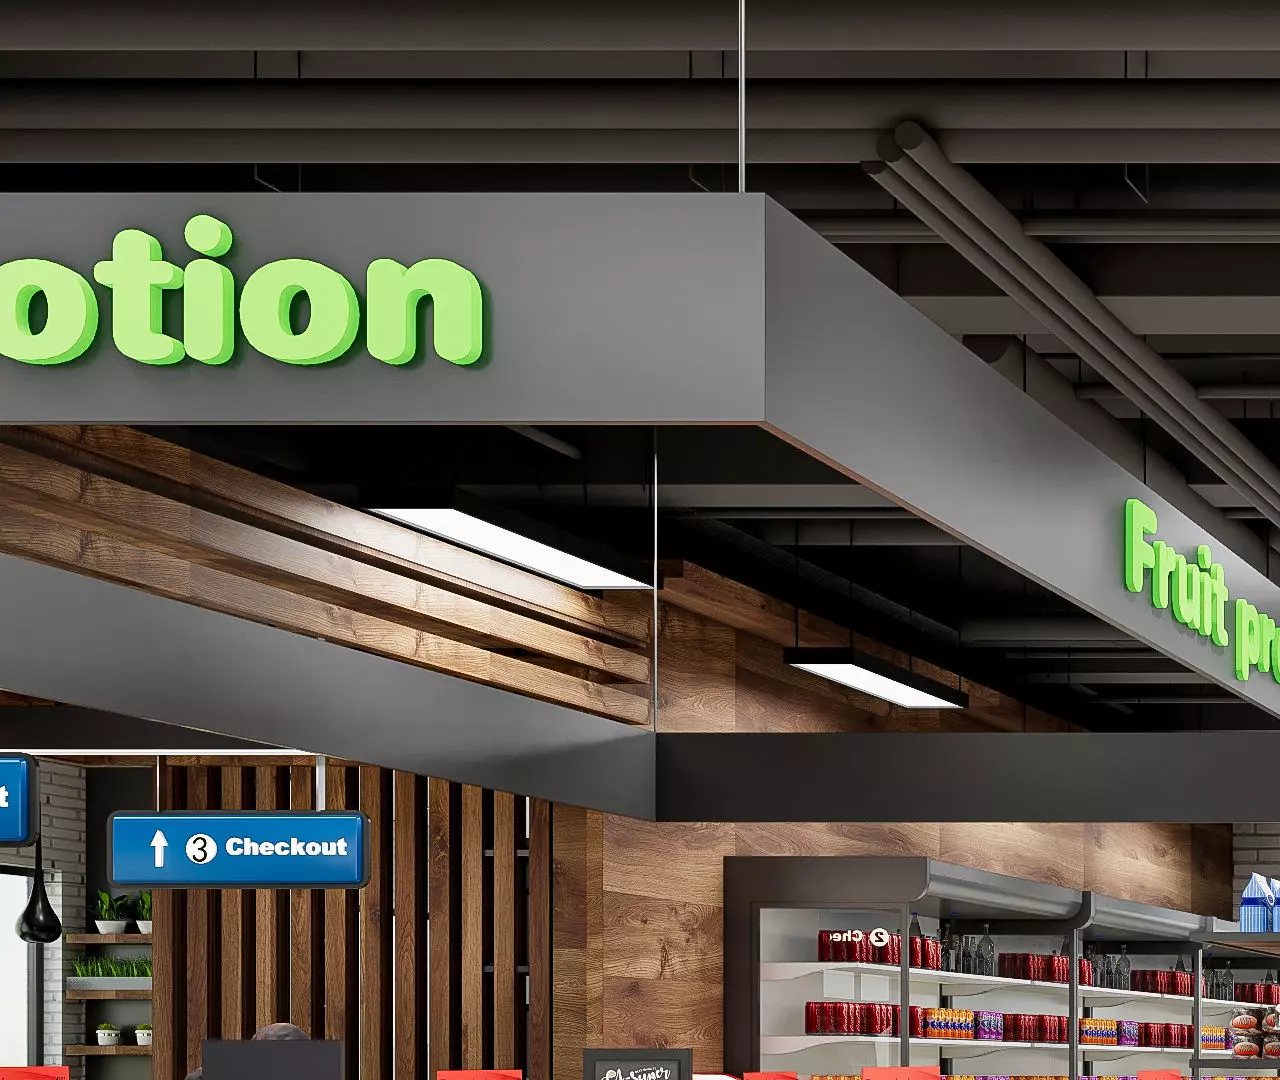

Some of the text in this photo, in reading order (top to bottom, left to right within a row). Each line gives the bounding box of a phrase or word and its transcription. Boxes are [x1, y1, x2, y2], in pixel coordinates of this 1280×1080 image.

[0, 214, 484, 365] otion
[1126, 499, 1229, 647] Fruit
[192, 836, 348, 863] 3 Checkout
